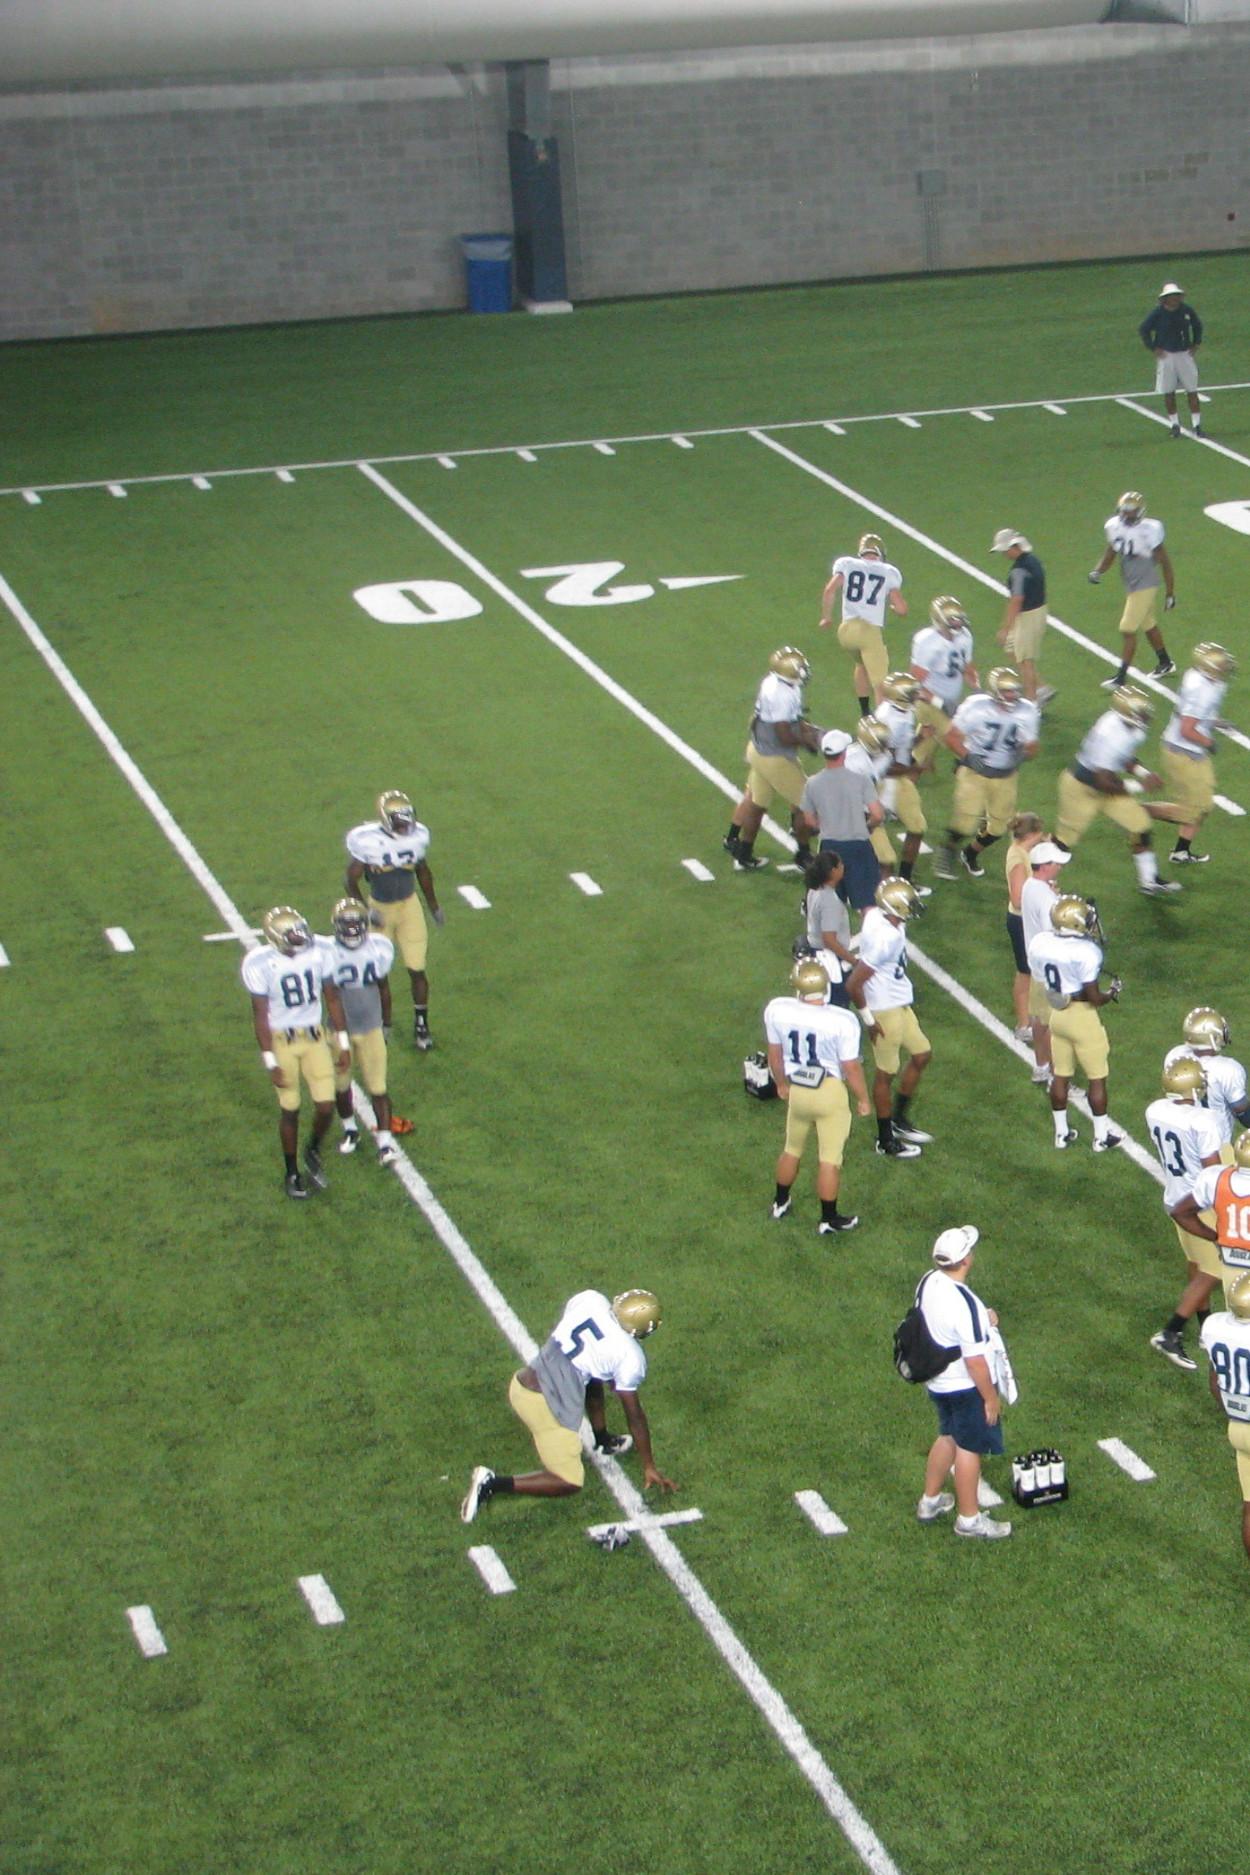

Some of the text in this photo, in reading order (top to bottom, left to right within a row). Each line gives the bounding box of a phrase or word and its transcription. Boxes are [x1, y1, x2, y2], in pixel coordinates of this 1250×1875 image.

[352, 560, 655, 624] 20
[846, 571, 886, 605] 87
[280, 969, 318, 1007] 81
[340, 962, 377, 989] 24
[788, 1030, 818, 1066] 11
[1152, 1125, 1187, 1177] 13
[560, 1317, 605, 1361] 5
